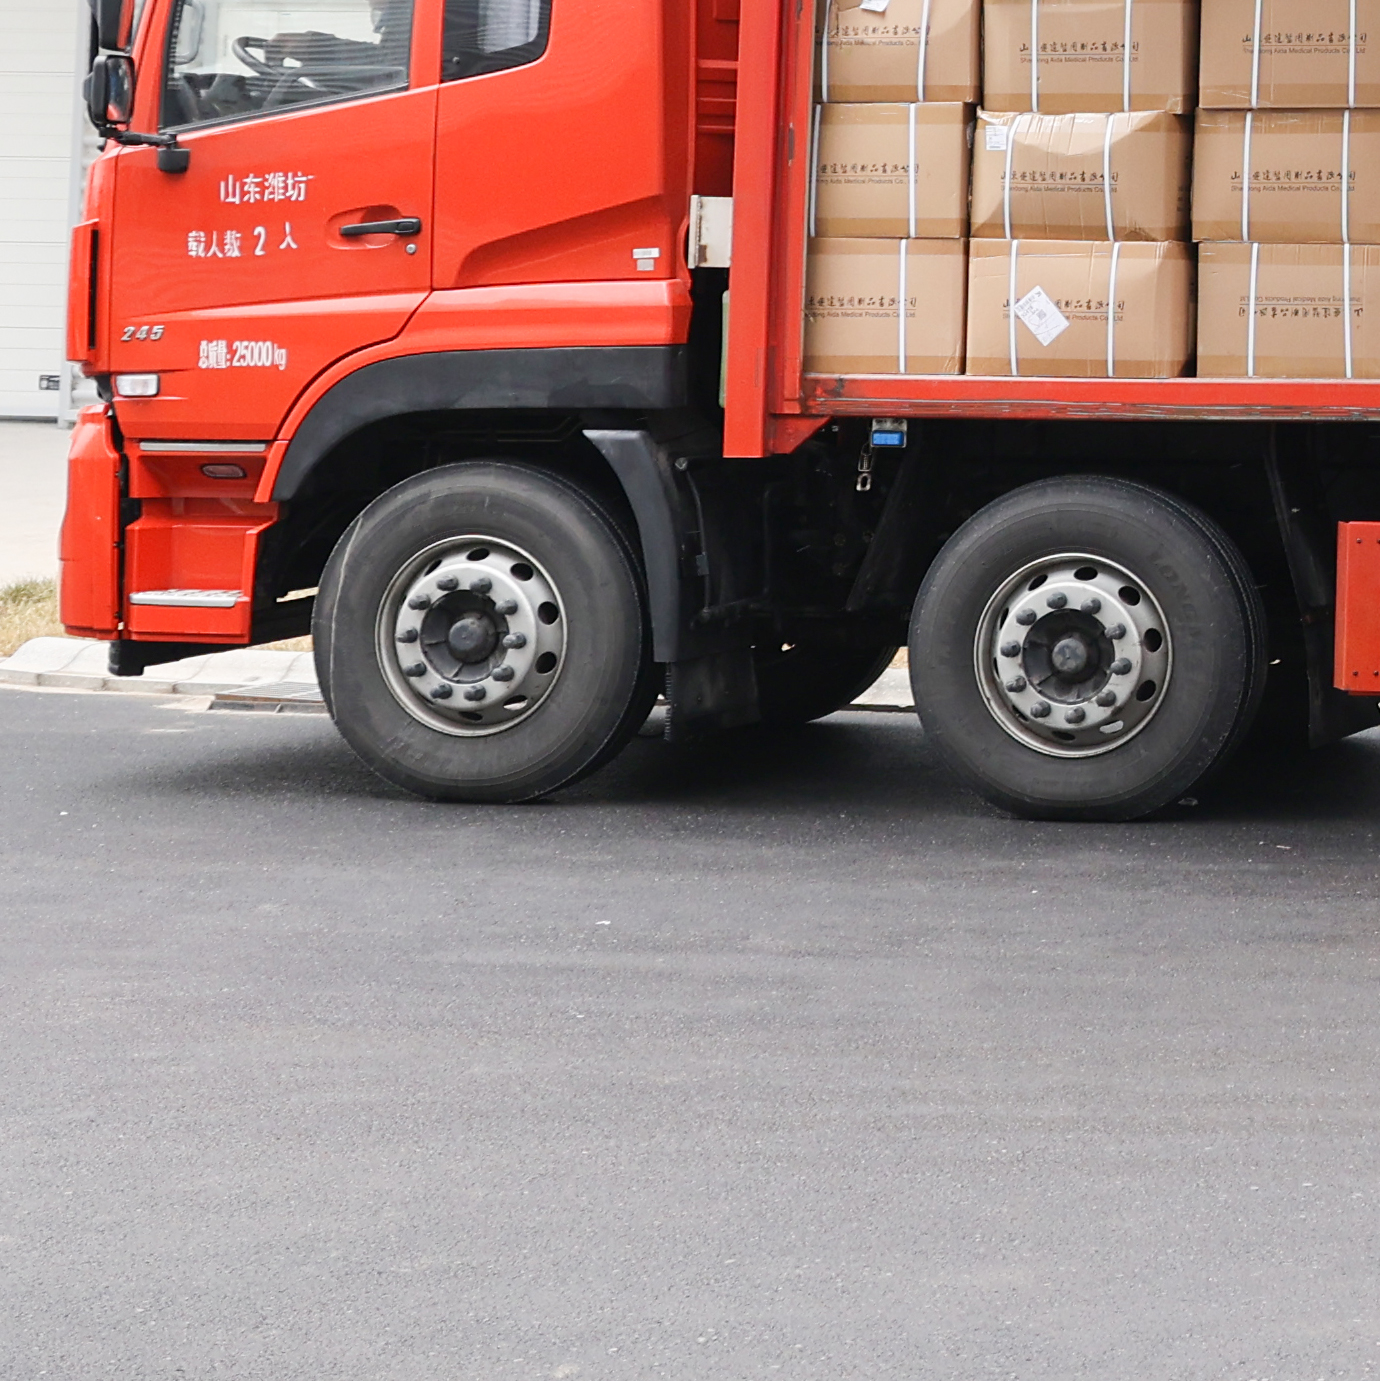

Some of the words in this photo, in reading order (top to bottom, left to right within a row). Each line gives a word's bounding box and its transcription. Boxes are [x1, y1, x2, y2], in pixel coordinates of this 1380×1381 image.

[220, 171, 312, 204] 山东潍坊
[253, 226, 266, 256] 2
[121, 325, 165, 342] 245
